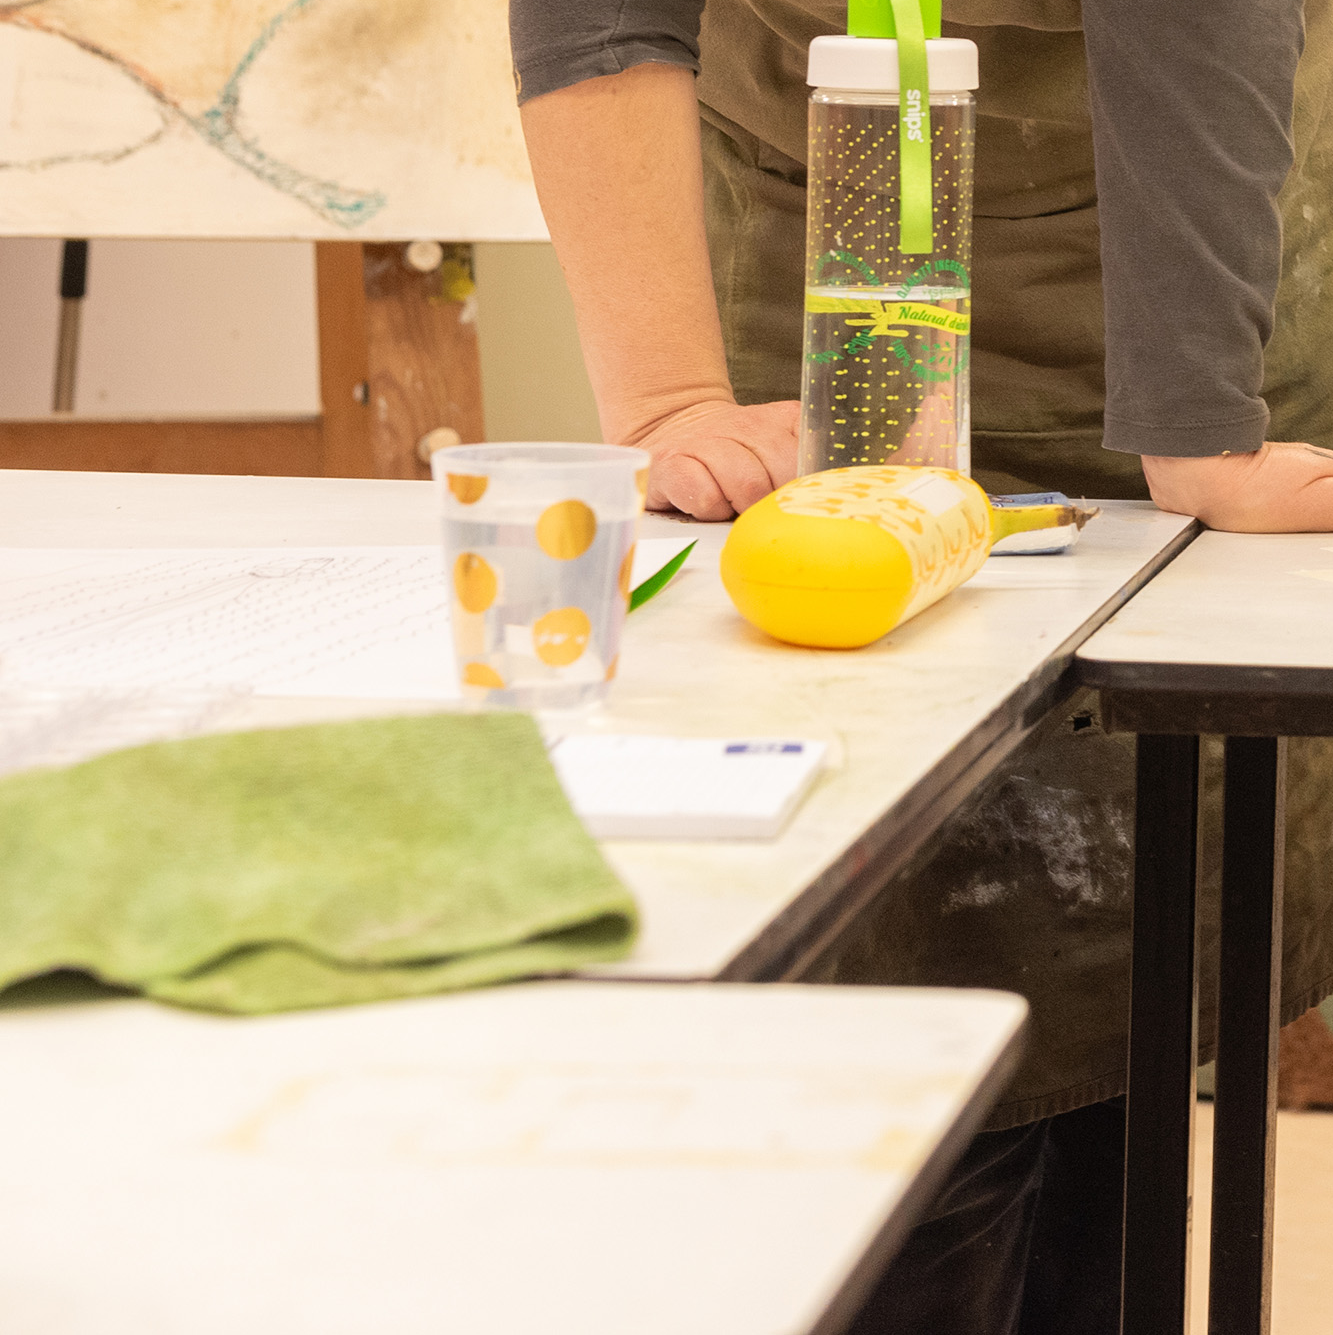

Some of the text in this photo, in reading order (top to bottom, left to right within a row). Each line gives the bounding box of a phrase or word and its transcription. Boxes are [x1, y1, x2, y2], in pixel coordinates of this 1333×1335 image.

[903, 89, 926, 142] snips
[896, 263, 933, 299] QUALITY
[898, 306, 950, 326] Natural
